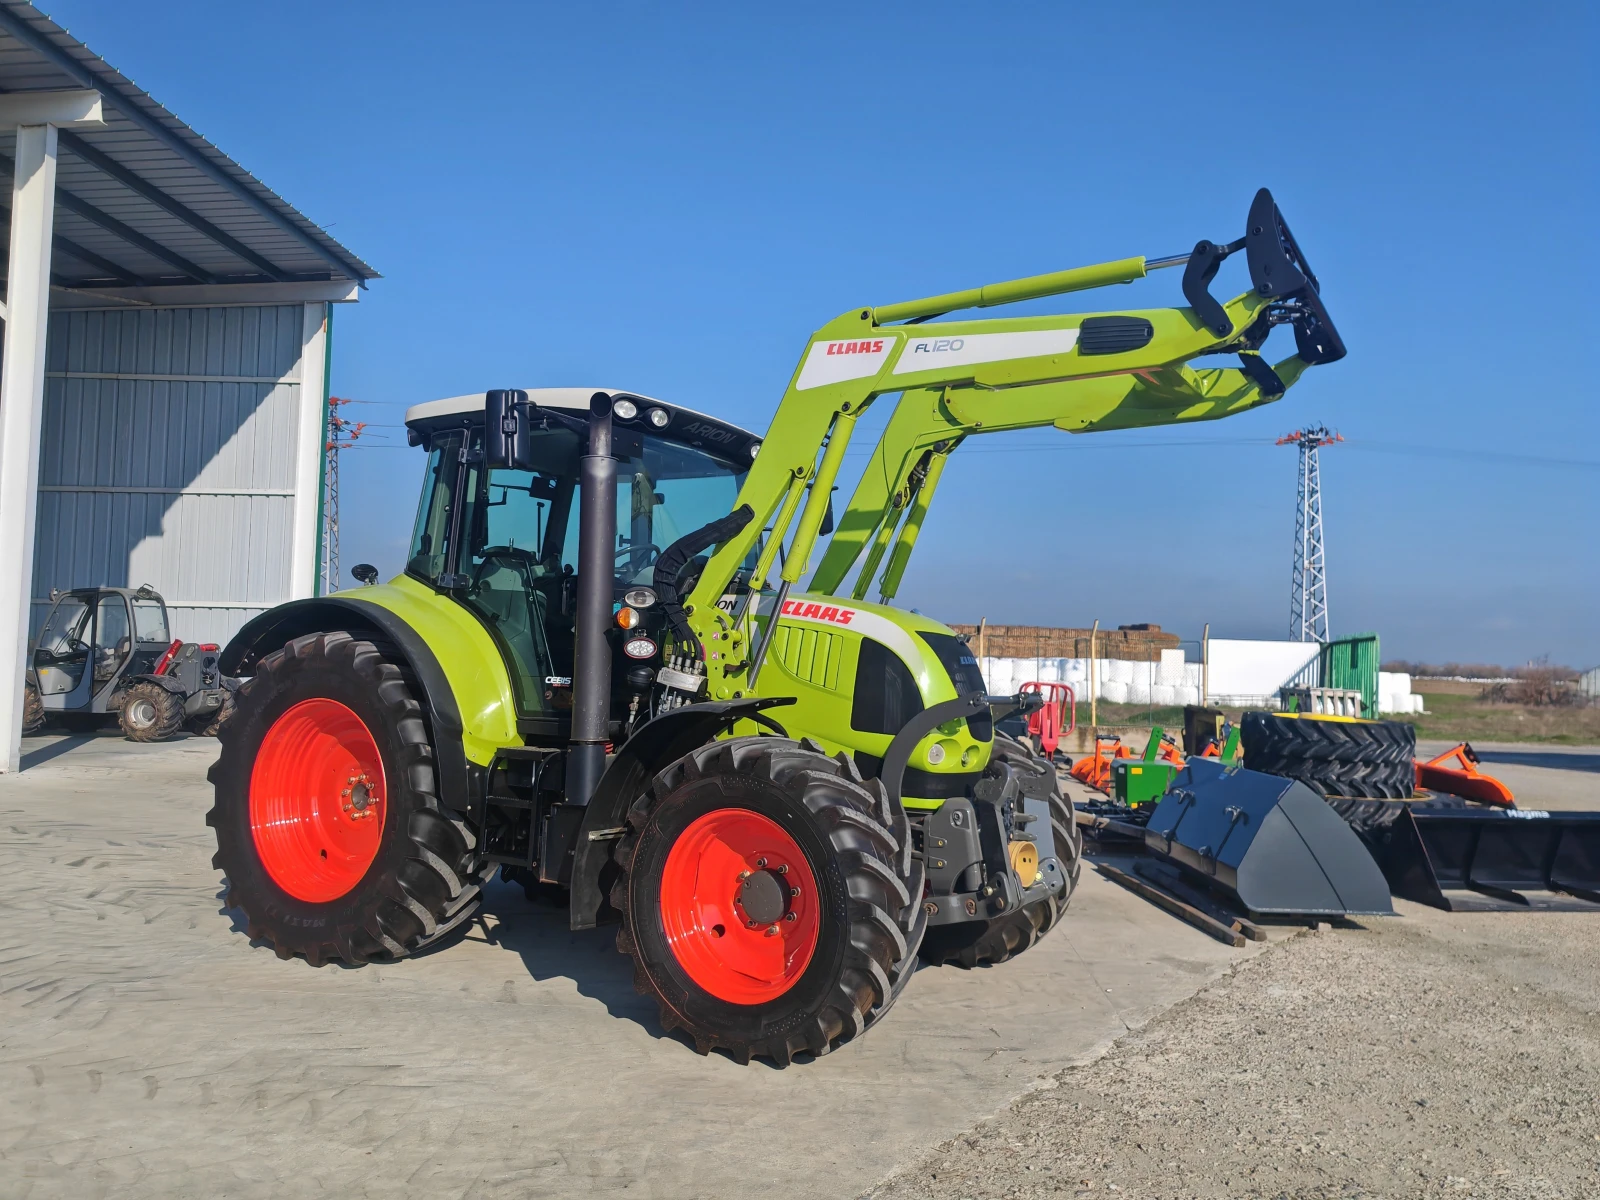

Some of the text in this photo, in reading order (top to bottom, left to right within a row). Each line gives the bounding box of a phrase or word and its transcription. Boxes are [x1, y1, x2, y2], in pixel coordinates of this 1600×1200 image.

[827, 341, 883, 355] CLAAS
[682, 421, 736, 443] ARION
[781, 601, 855, 624] CLAAS
[545, 676, 571, 684] CEBIS
